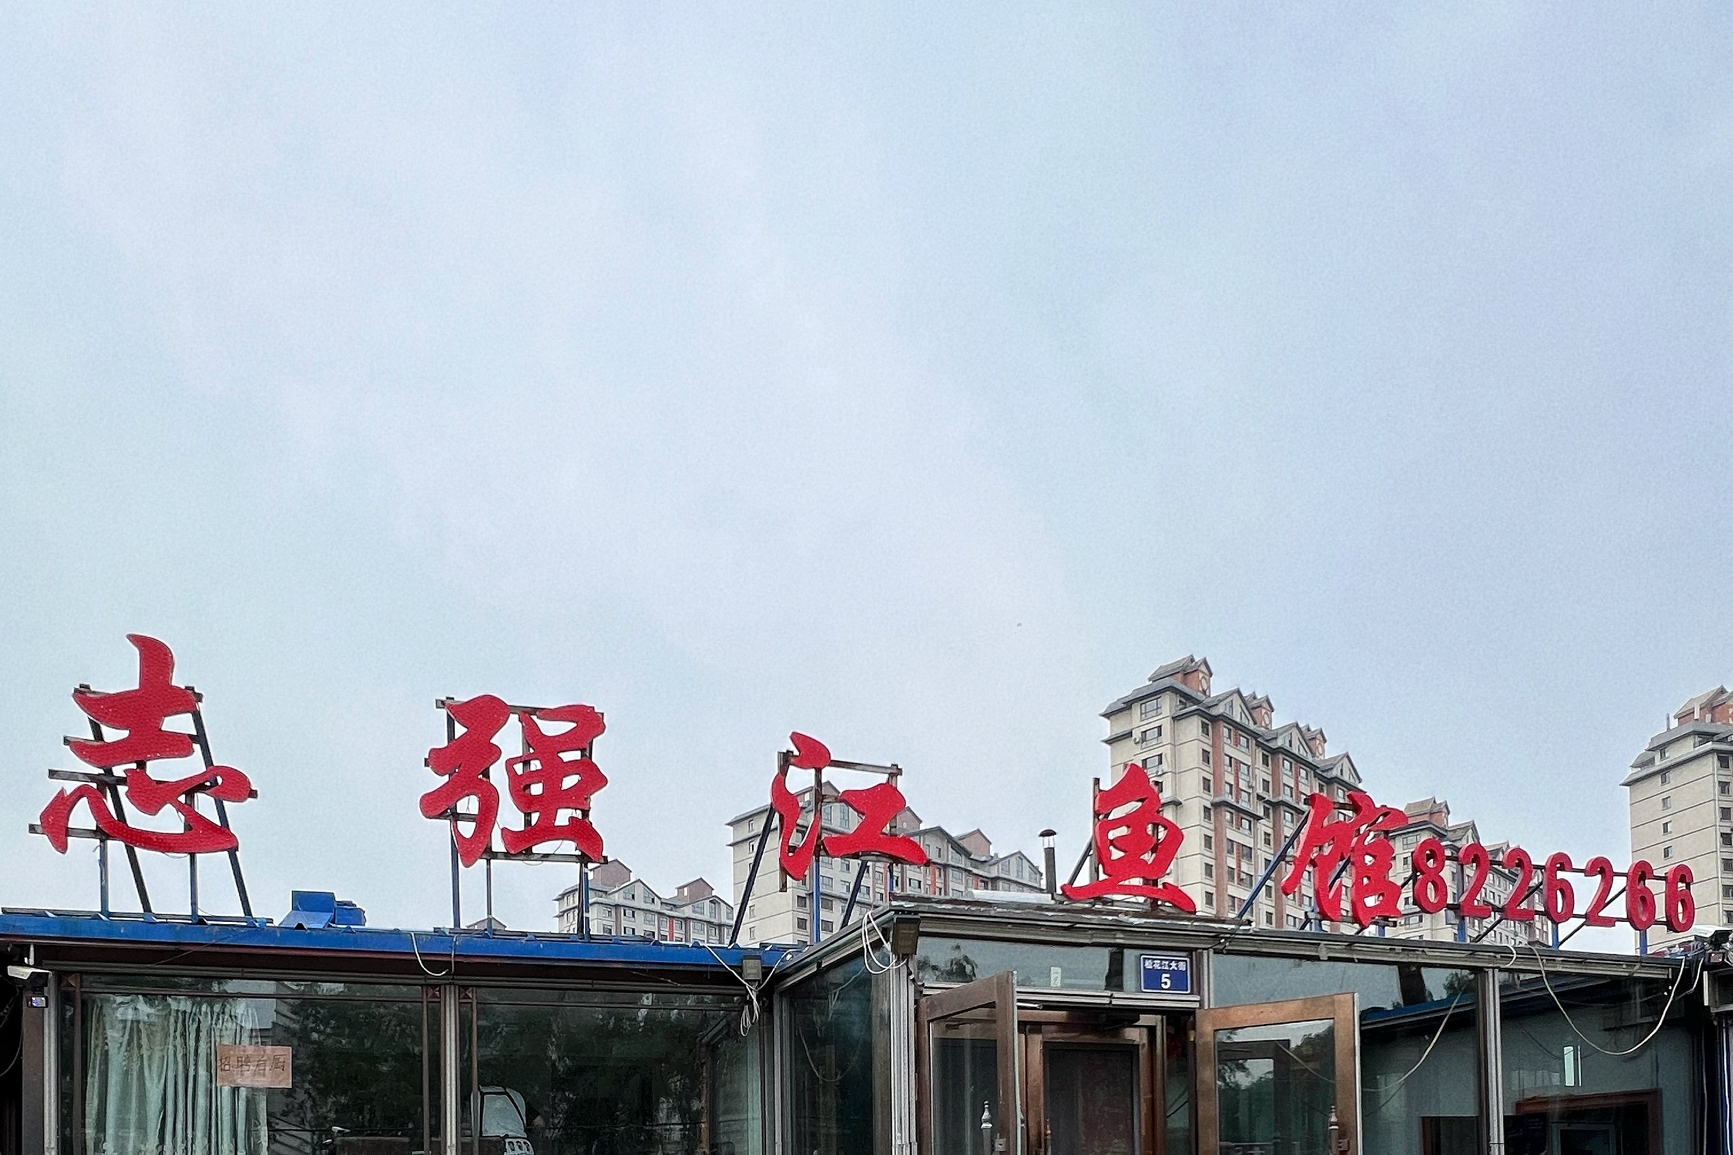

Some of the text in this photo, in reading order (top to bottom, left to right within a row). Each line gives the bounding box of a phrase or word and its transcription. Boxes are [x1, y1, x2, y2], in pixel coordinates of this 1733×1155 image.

[41, 634, 1696, 933] 志强江鱼馆 8226266
[1161, 973, 1171, 989] 5
